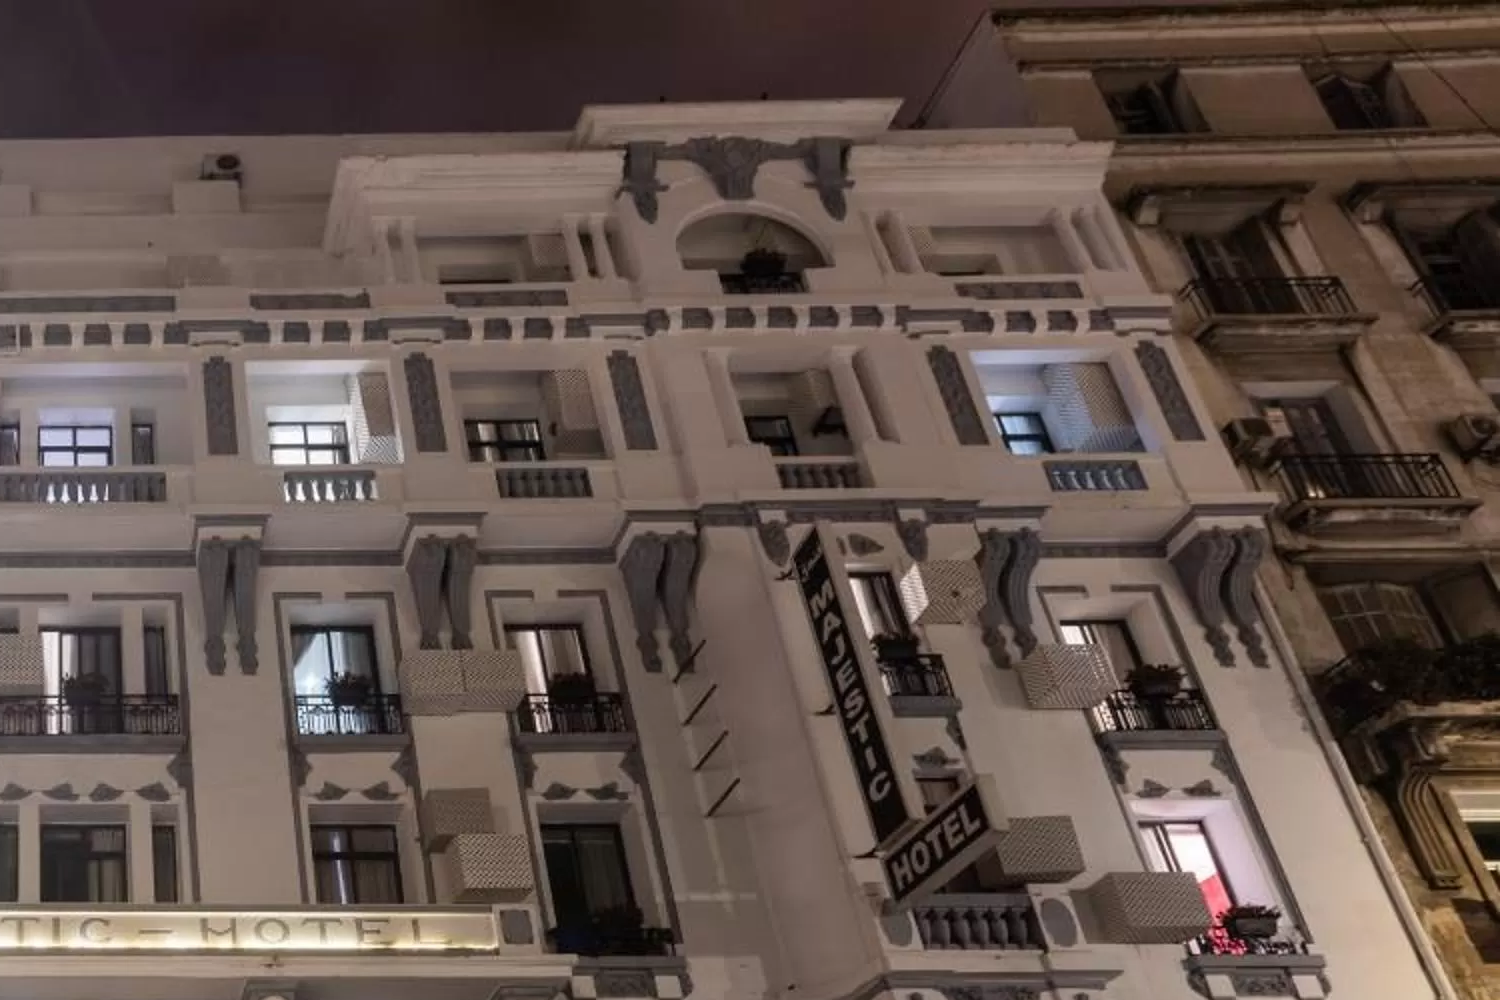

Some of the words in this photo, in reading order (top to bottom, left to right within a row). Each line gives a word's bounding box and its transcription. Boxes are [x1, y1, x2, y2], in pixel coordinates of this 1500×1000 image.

[808, 578, 892, 803] MAJESTIC
[891, 801, 982, 891] HOTEL
[200, 916, 453, 946] HOTEL
